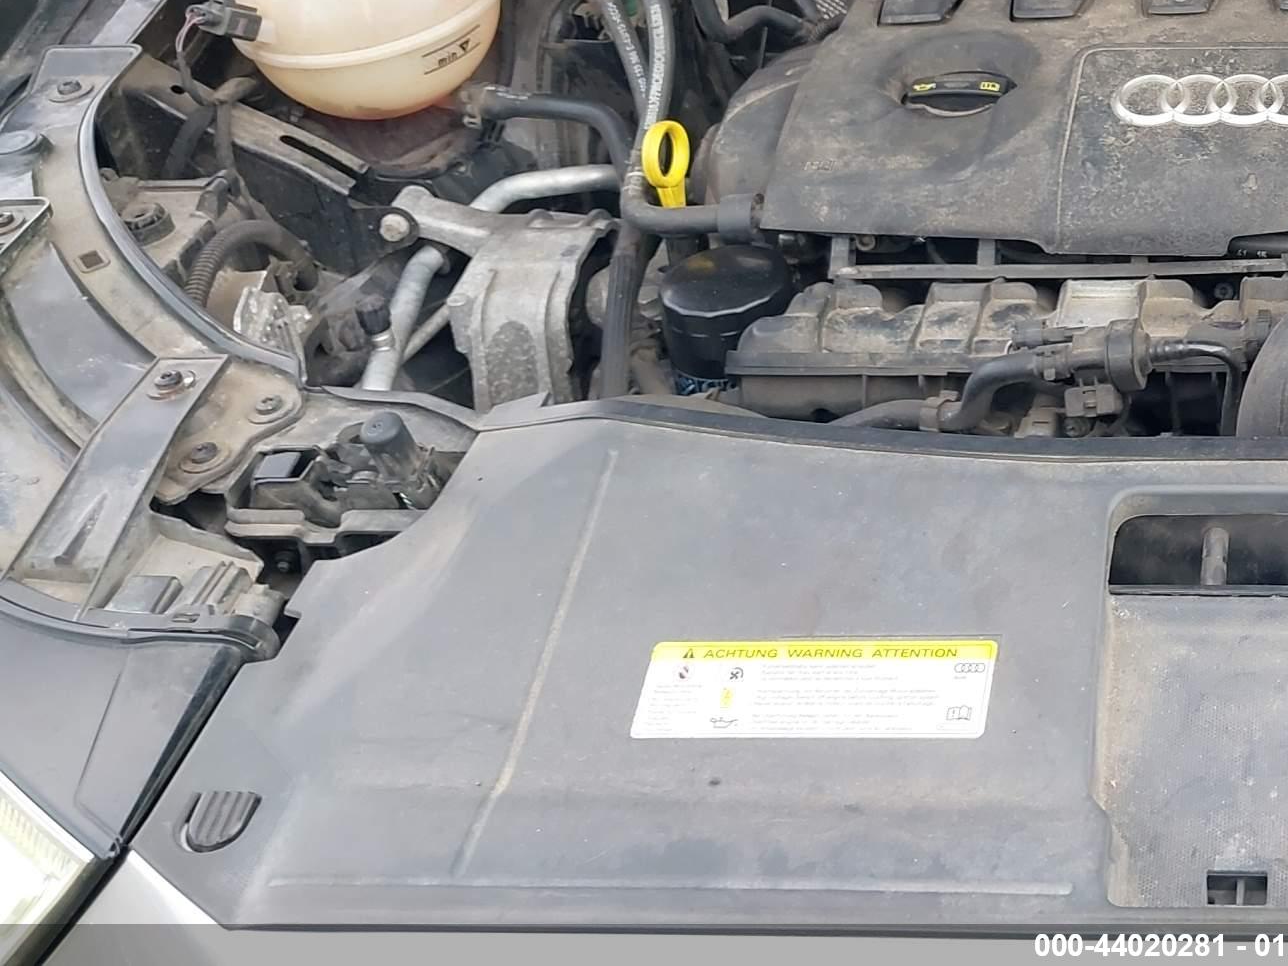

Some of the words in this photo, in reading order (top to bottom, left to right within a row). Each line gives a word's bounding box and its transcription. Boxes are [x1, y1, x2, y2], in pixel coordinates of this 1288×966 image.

[437, 51, 458, 68] min
[703, 648, 778, 659] ACHTUNG
[787, 648, 863, 659] WARNING
[871, 648, 959, 658] ATTENTION
